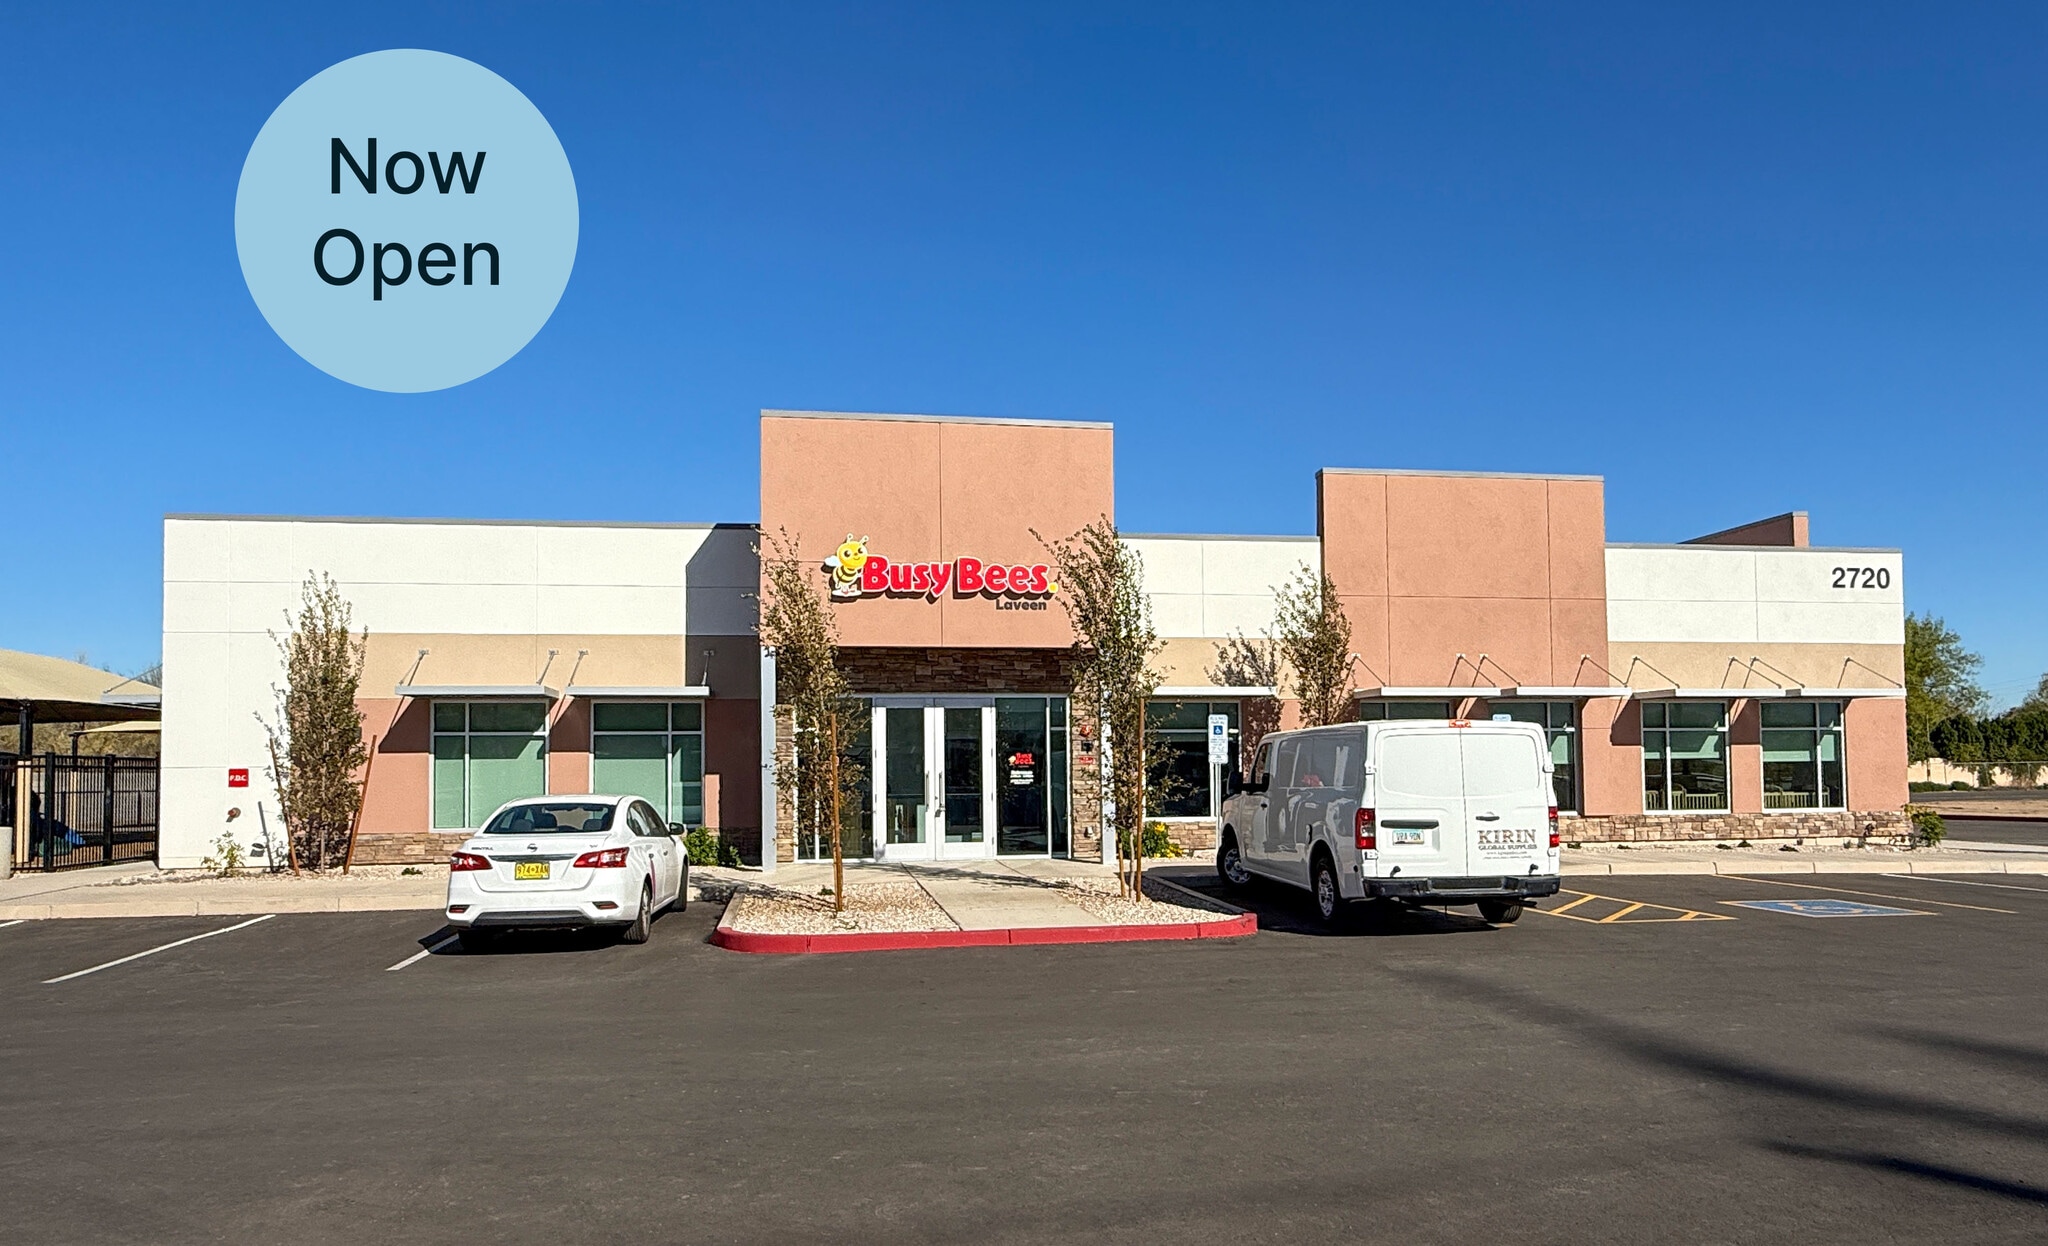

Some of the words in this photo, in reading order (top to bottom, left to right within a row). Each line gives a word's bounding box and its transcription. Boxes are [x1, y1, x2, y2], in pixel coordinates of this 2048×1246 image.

[861, 554, 952, 600] Busy
[1832, 567, 1890, 589] 2720
[996, 599, 1047, 611] Laveen
[1477, 829, 1536, 844] KIRIN
